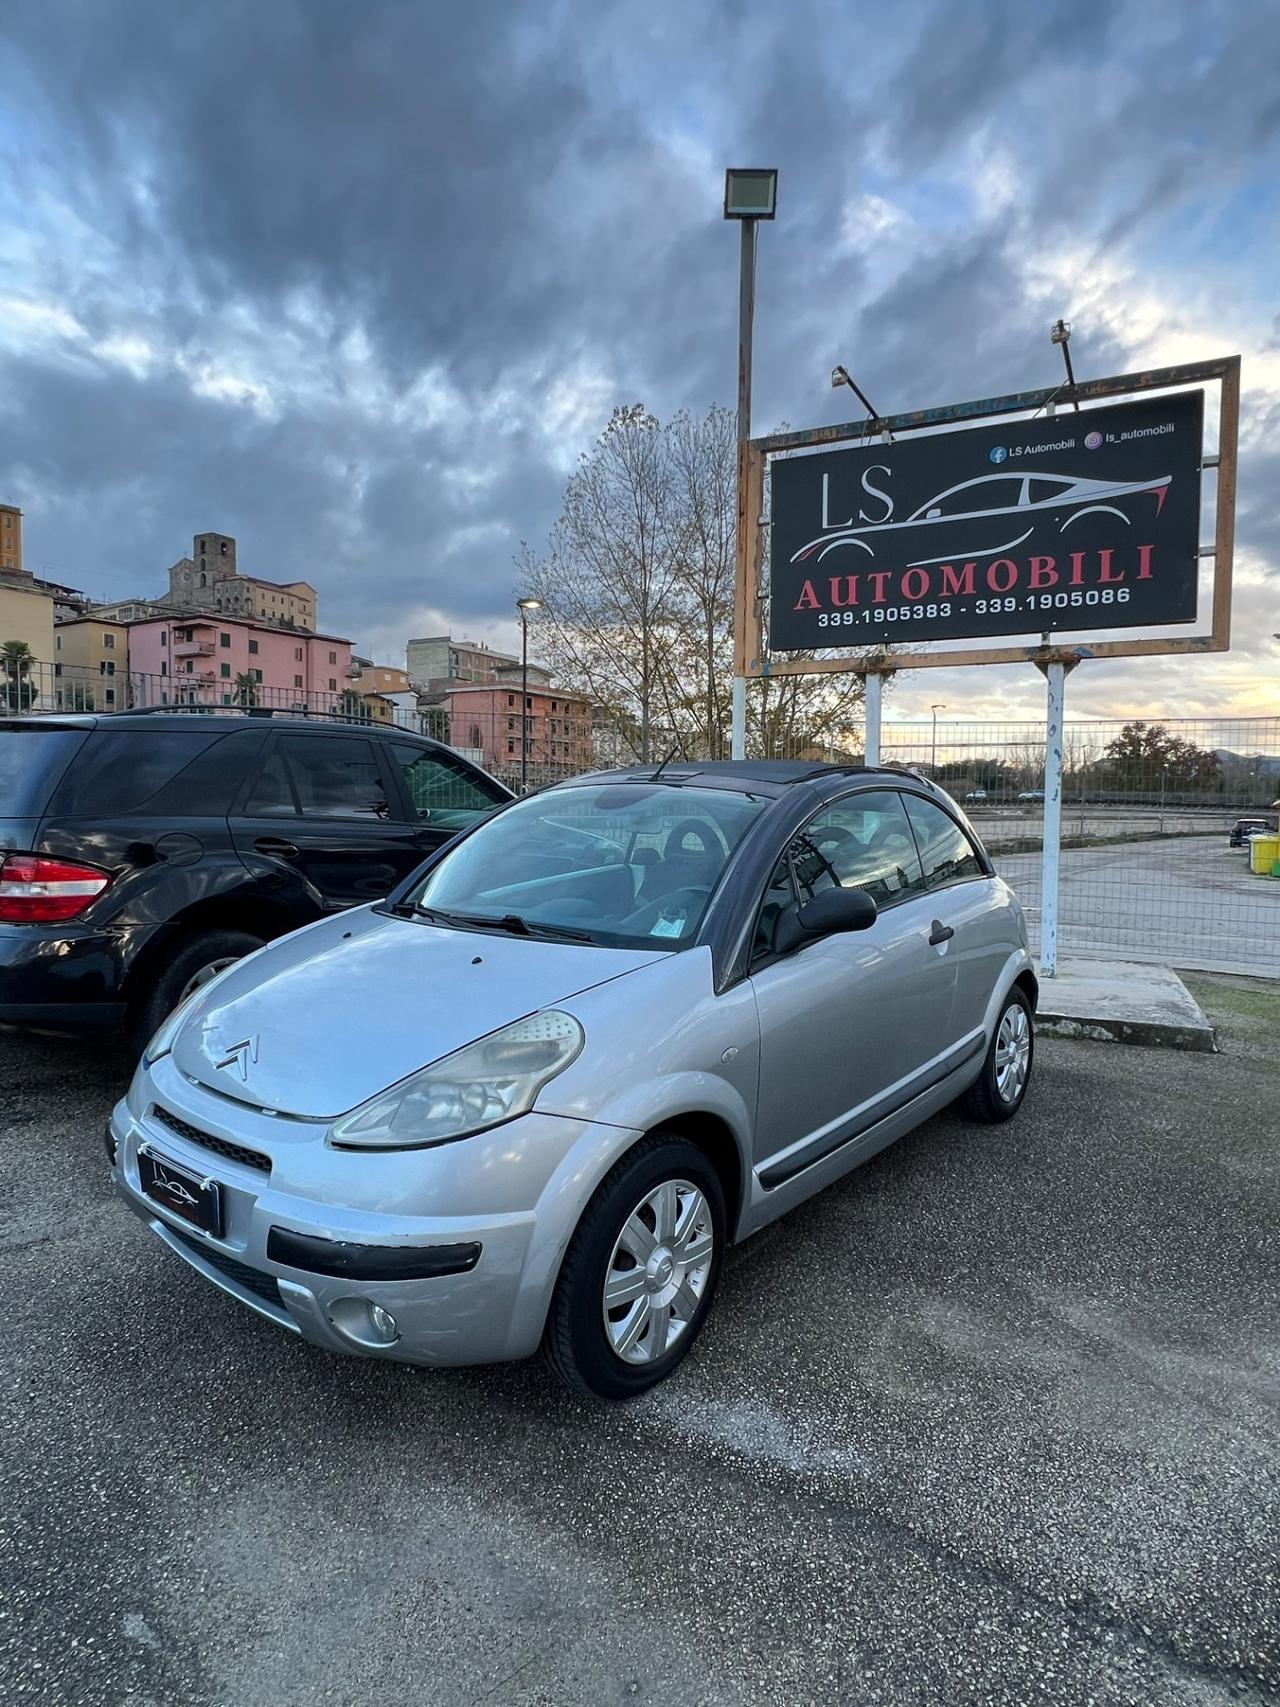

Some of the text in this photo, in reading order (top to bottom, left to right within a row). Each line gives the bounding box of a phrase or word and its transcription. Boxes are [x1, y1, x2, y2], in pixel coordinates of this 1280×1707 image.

[1009, 438, 1076, 457] LS Automobili
[822, 465, 894, 529] LS
[793, 545, 1155, 611] AUTOMOBILI
[818, 603, 951, 627] 339.1905383
[975, 588, 1130, 614] 339.1905086
